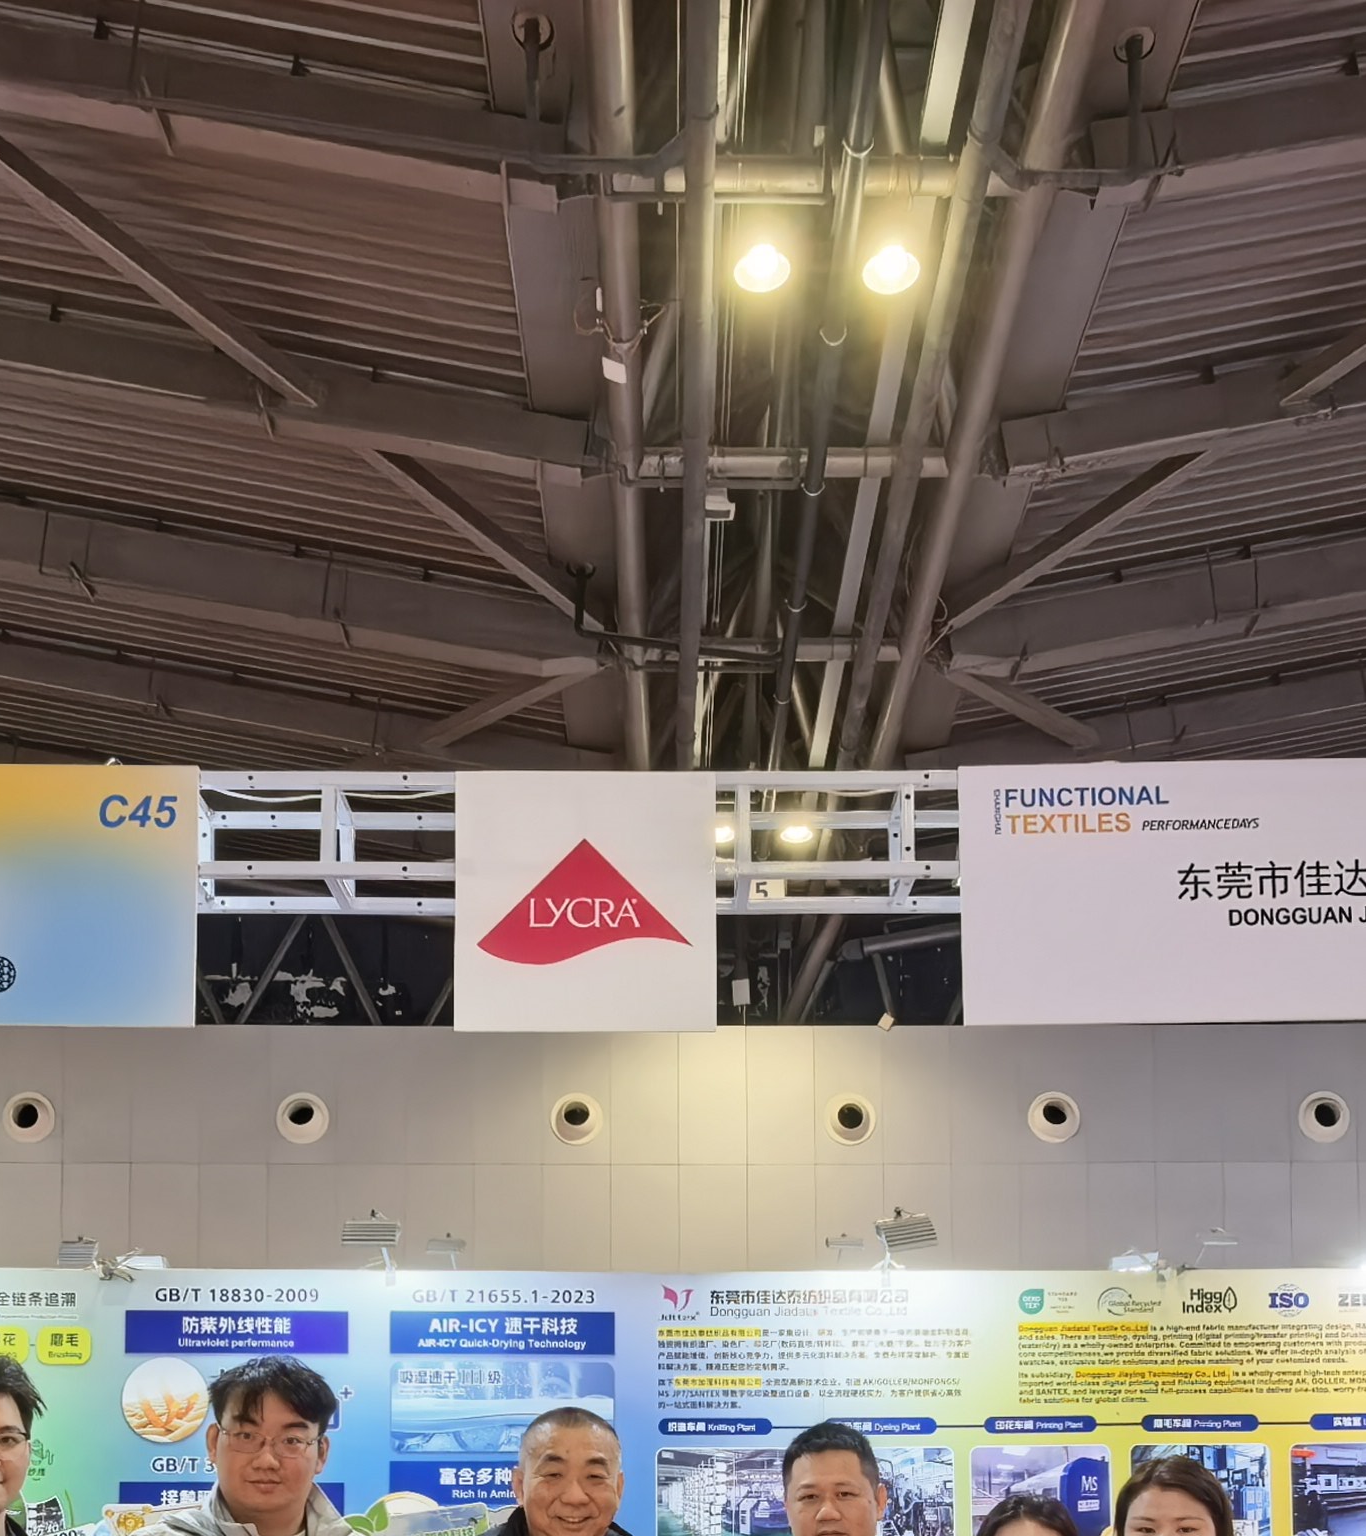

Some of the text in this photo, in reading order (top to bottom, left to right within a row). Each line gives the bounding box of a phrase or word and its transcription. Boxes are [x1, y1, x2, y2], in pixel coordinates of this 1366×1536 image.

[1005, 786, 1169, 807] FUNCTIONAL
[99, 795, 178, 828] C45
[1006, 812, 1260, 834] TEXTILES PERFORMANCEDAYS
[755, 881, 769, 898] 5
[529, 897, 639, 928] LYCRA
[1228, 907, 1353, 926] DONGGUAN
[155, 1288, 319, 1303] GB/T 18830-2009
[413, 1289, 595, 1304] GB/T 21655.1-2023
[1189, 1288, 1223, 1303] Higg
[1268, 1292, 1310, 1308] ISO
[710, 1306, 771, 1319] Dongguan
[1182, 1301, 1222, 1313] Index
[182, 1316, 291, 1334] 防紫外线性能
[429, 1317, 578, 1335] AIR-ICY 速干科技
[50, 1333, 79, 1347] 磨毛
[178, 1338, 294, 1349] Ultraviolet performance
[418, 1339, 586, 1351] AIR-ICY Quick-Drying Technology
[737, 1422, 756, 1432] Plant
[902, 1421, 921, 1431] Plant
[1036, 1421, 1063, 1431] Printing
[1065, 1420, 1084, 1429] Plant
[1223, 1419, 1242, 1428] Plant
[151, 1457, 199, 1473] GB/T
[439, 1468, 512, 1486] 富含多种
[1081, 1476, 1099, 1493] MS
[452, 1489, 475, 1499] Rich
[490, 1489, 517, 1499] Amin
